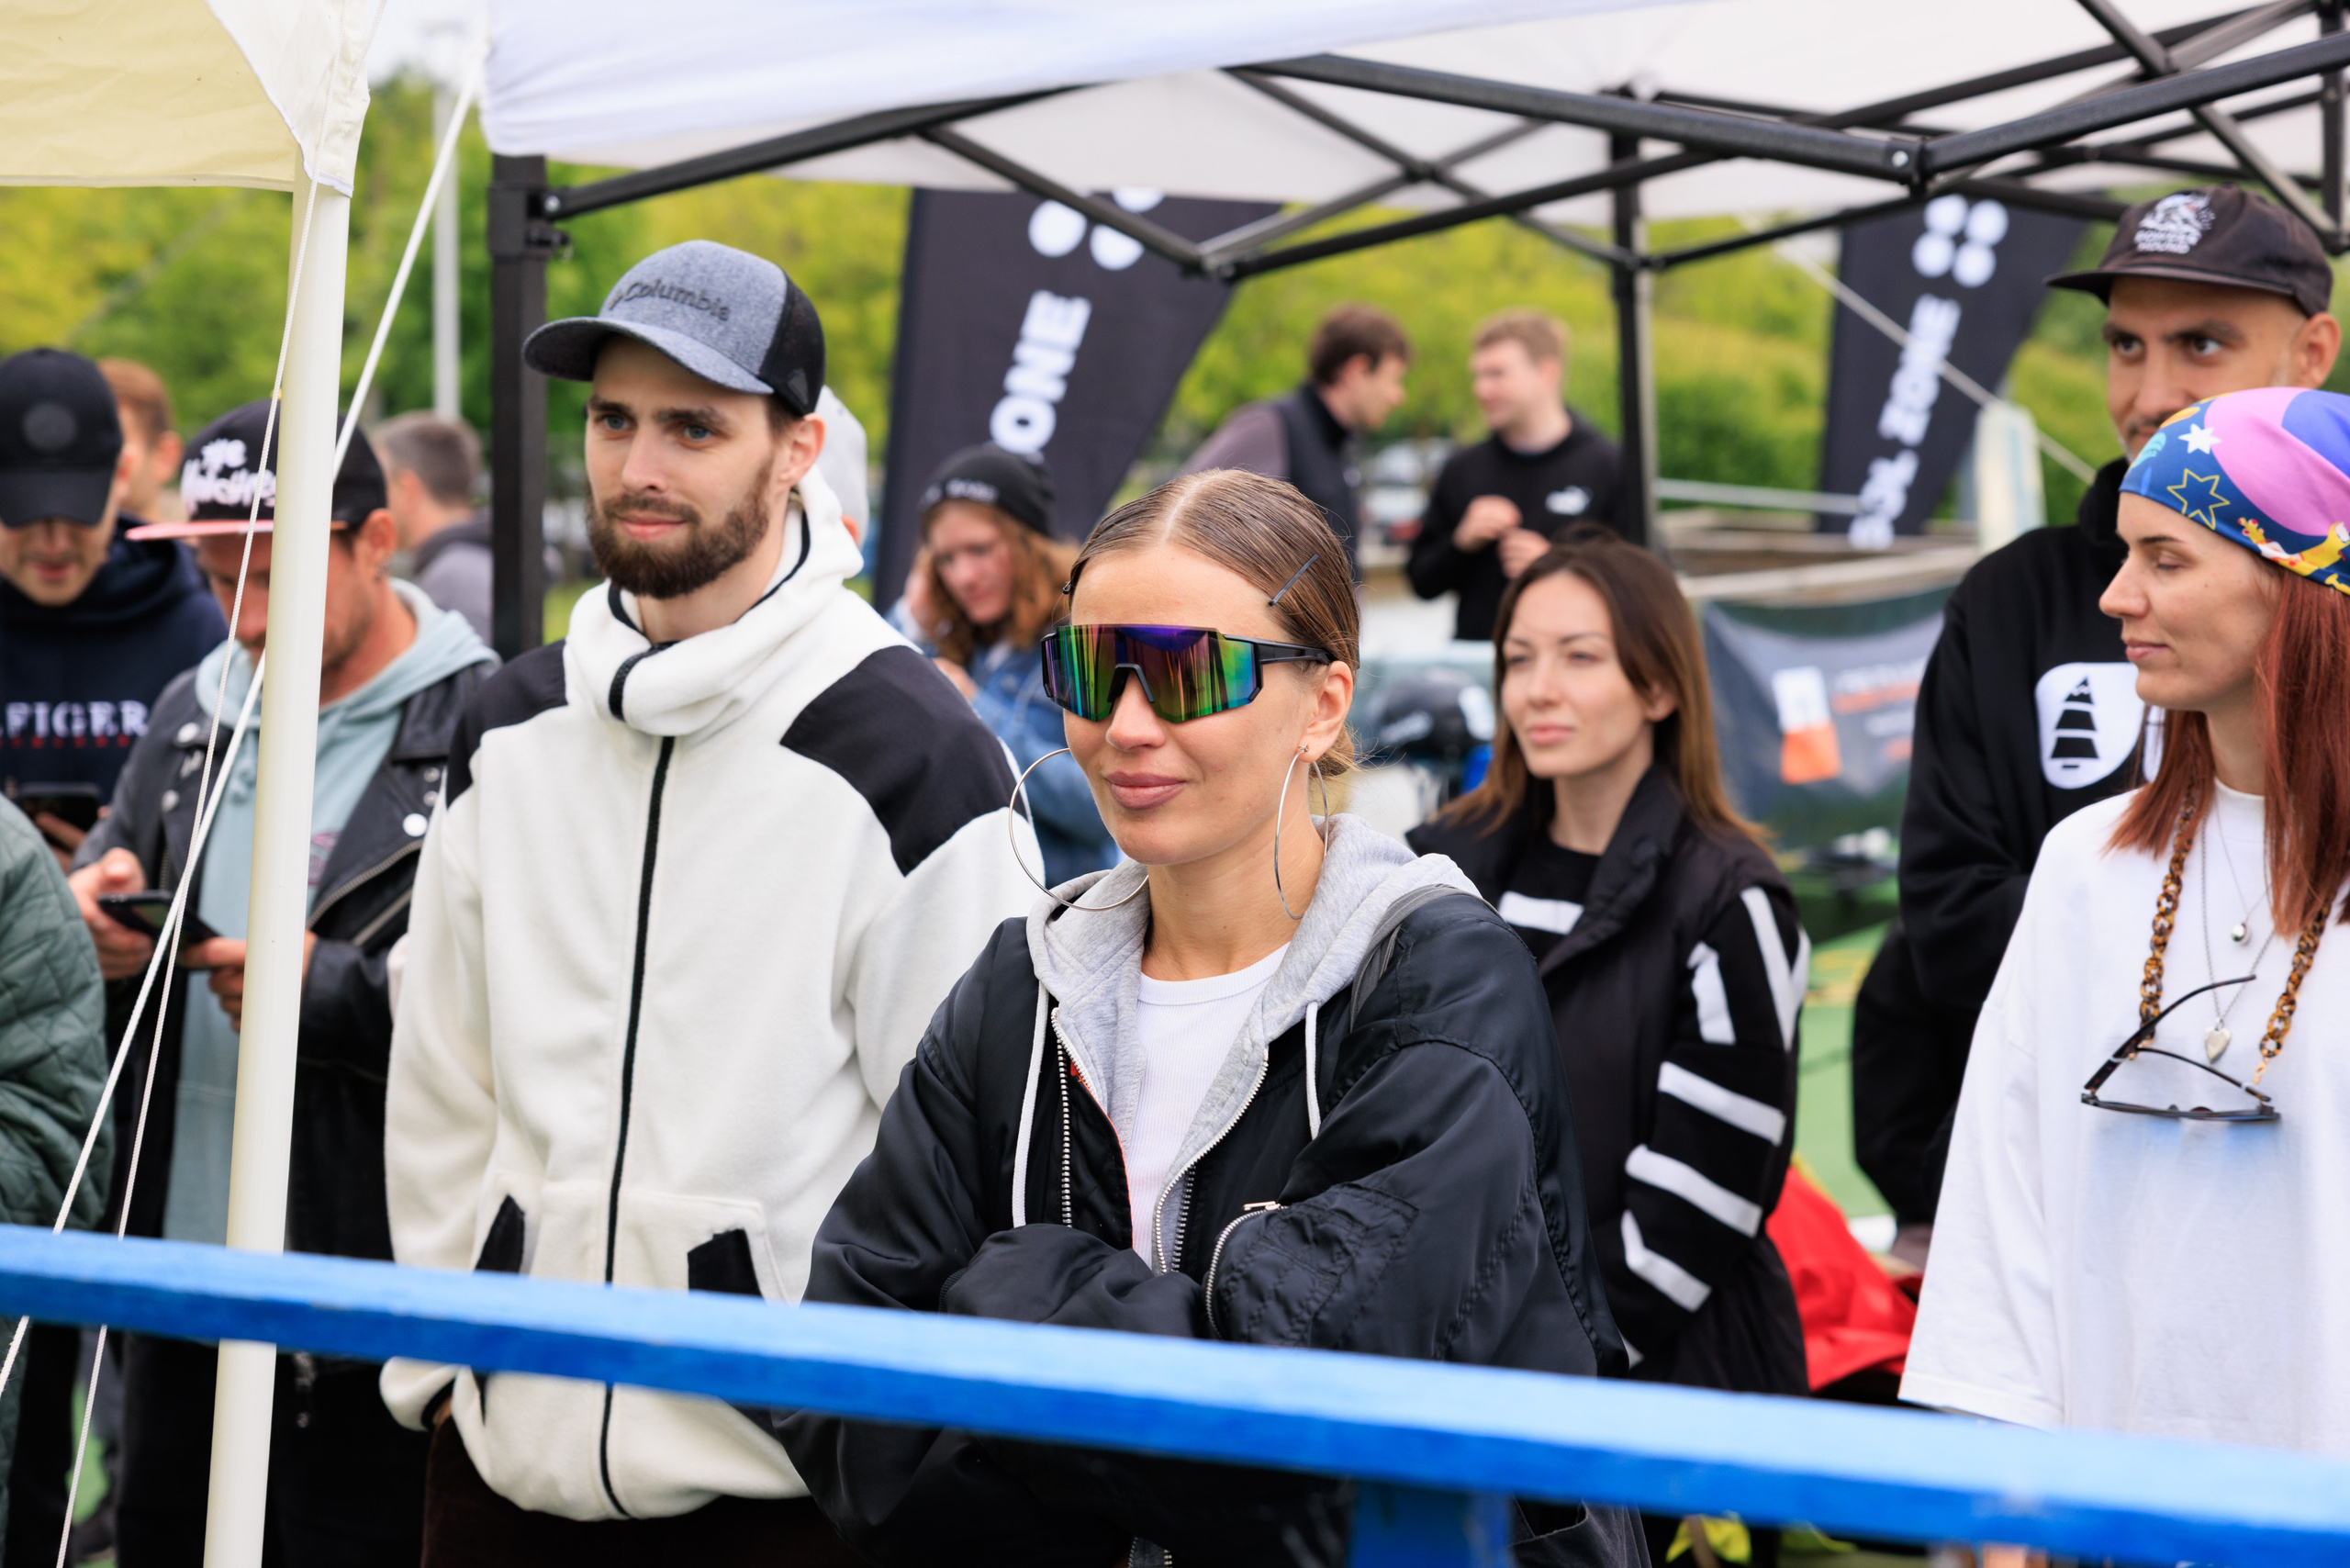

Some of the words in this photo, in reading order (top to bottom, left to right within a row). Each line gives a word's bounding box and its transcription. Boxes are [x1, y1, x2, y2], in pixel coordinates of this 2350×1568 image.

[624, 278, 730, 321] Columbia
[990, 289, 1092, 464] ONE
[1877, 293, 1962, 447] ZONE
[0, 700, 149, 738] FIGER
